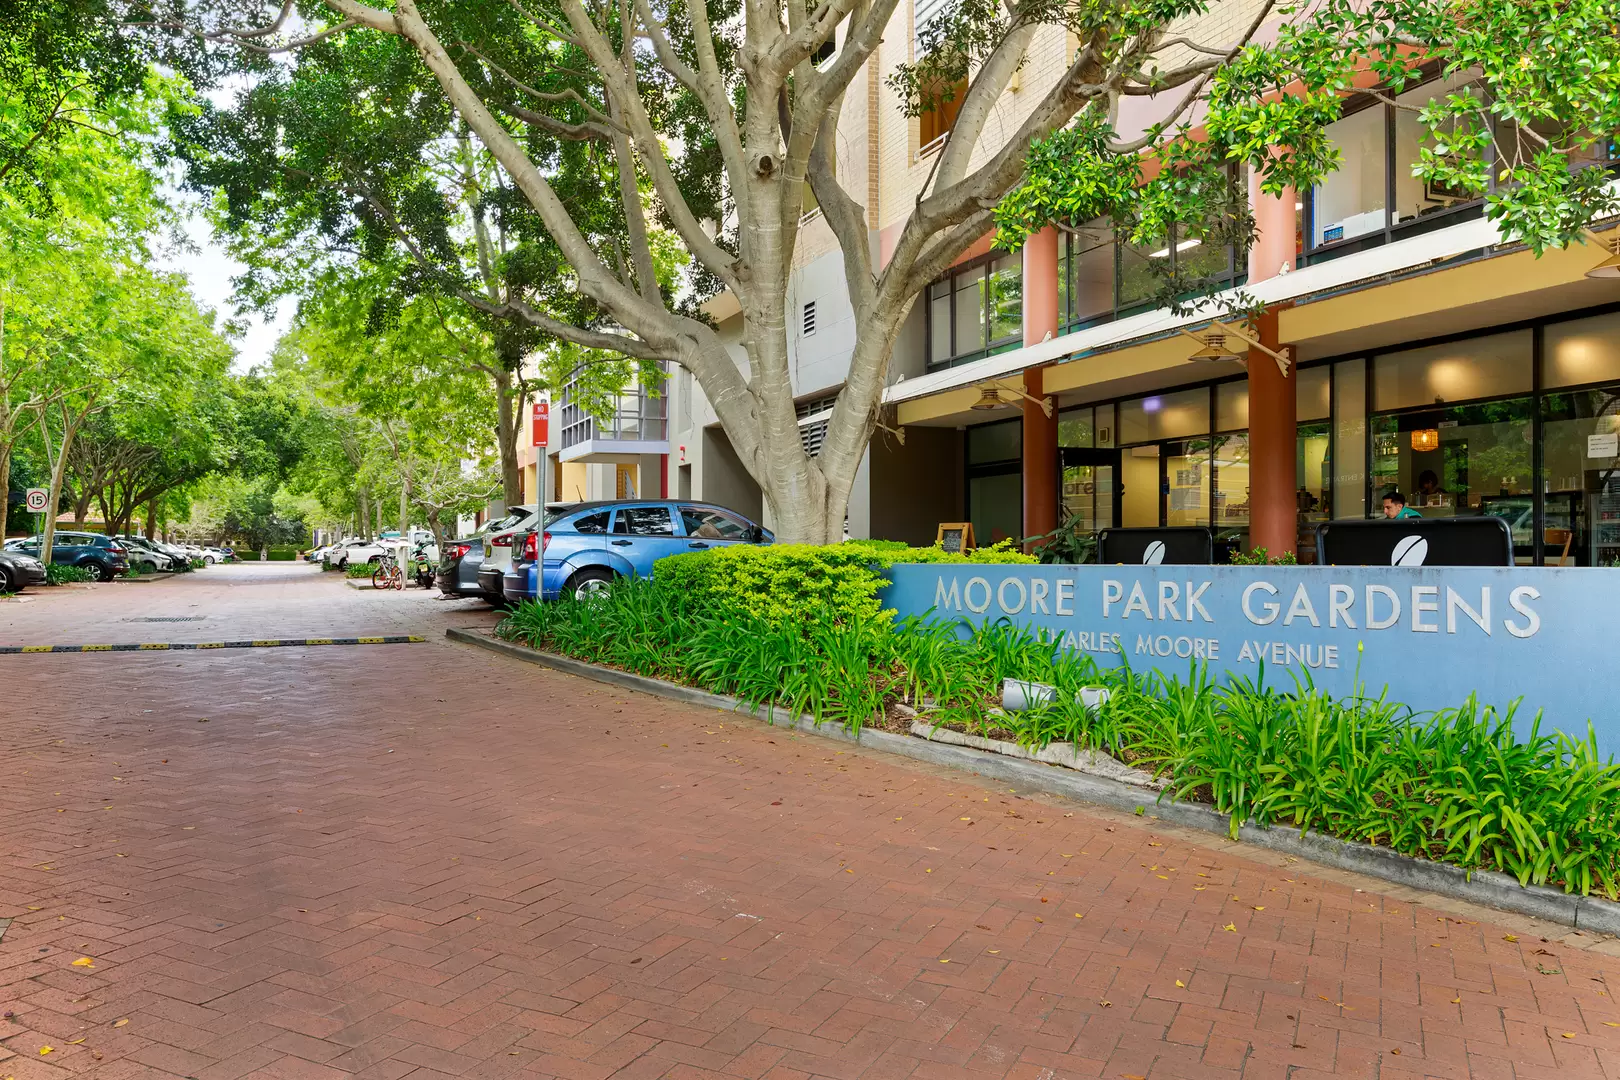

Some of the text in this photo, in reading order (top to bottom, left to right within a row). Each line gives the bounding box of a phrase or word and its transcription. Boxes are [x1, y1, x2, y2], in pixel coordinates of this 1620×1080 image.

[537, 405, 545, 413] NO
[31, 495, 43, 505] 15
[934, 575, 1542, 639] MOORE PARK GARDENS
[1135, 634, 1220, 660] MOORE
[1236, 640, 1339, 669] AVENUE
